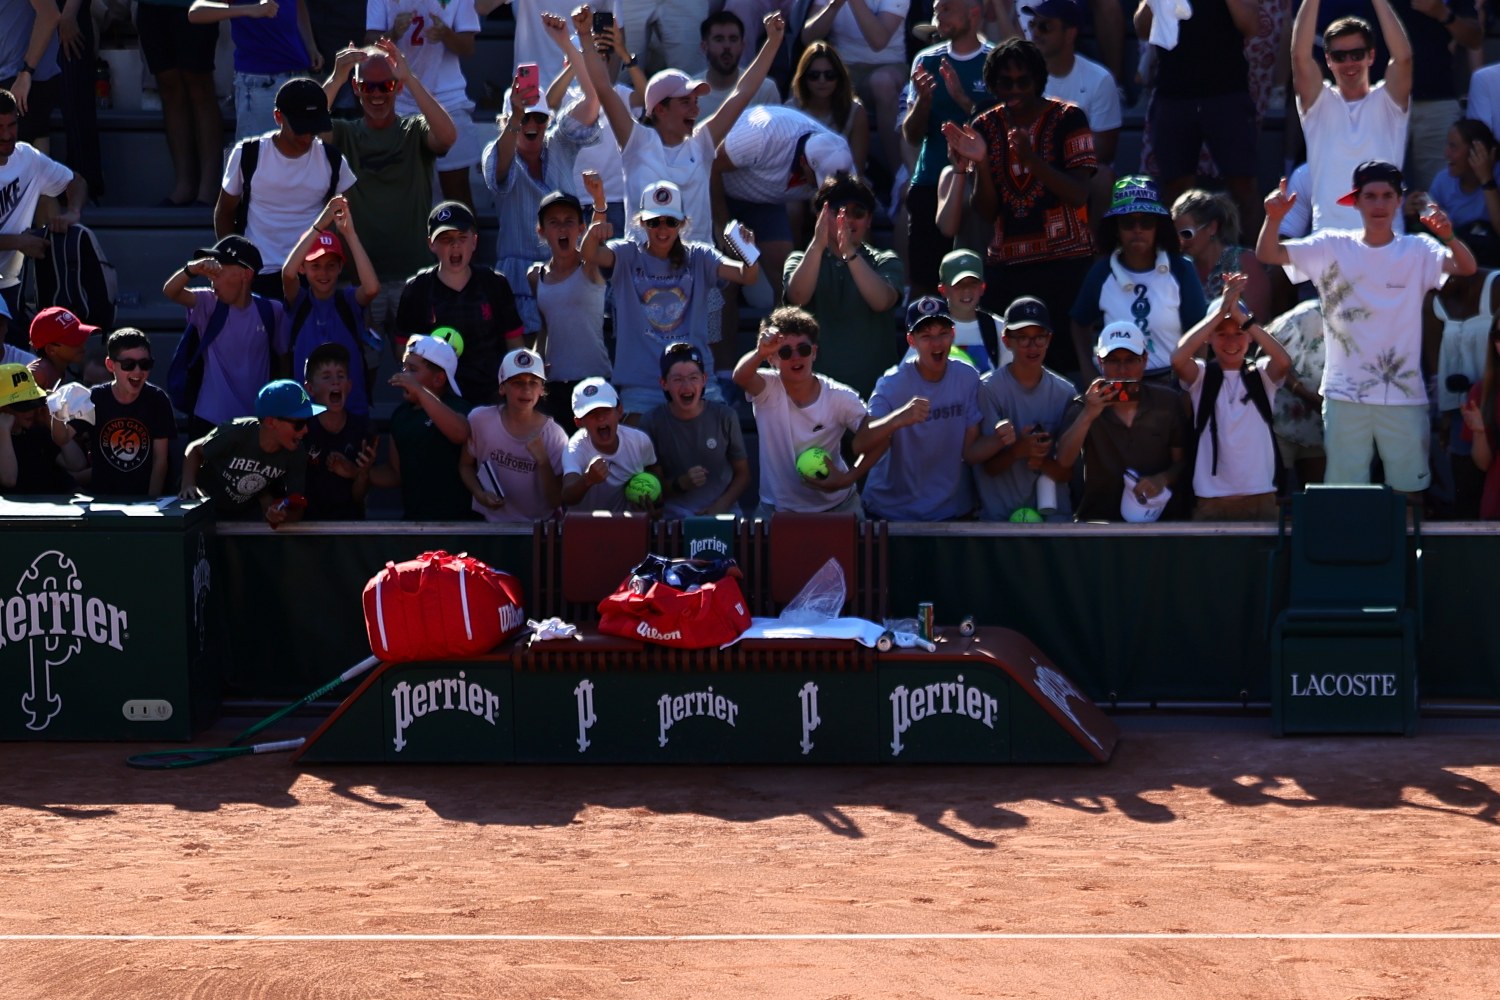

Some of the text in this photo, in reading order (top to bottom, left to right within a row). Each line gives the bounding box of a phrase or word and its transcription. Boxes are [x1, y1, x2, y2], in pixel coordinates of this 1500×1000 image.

[1110, 332, 1131, 340] FILA
[228, 457, 286, 479] IRELAN
[0, 578, 128, 652] errier
[636, 621, 682, 641] Wilson
[1290, 674, 1397, 696] LACOSTE
